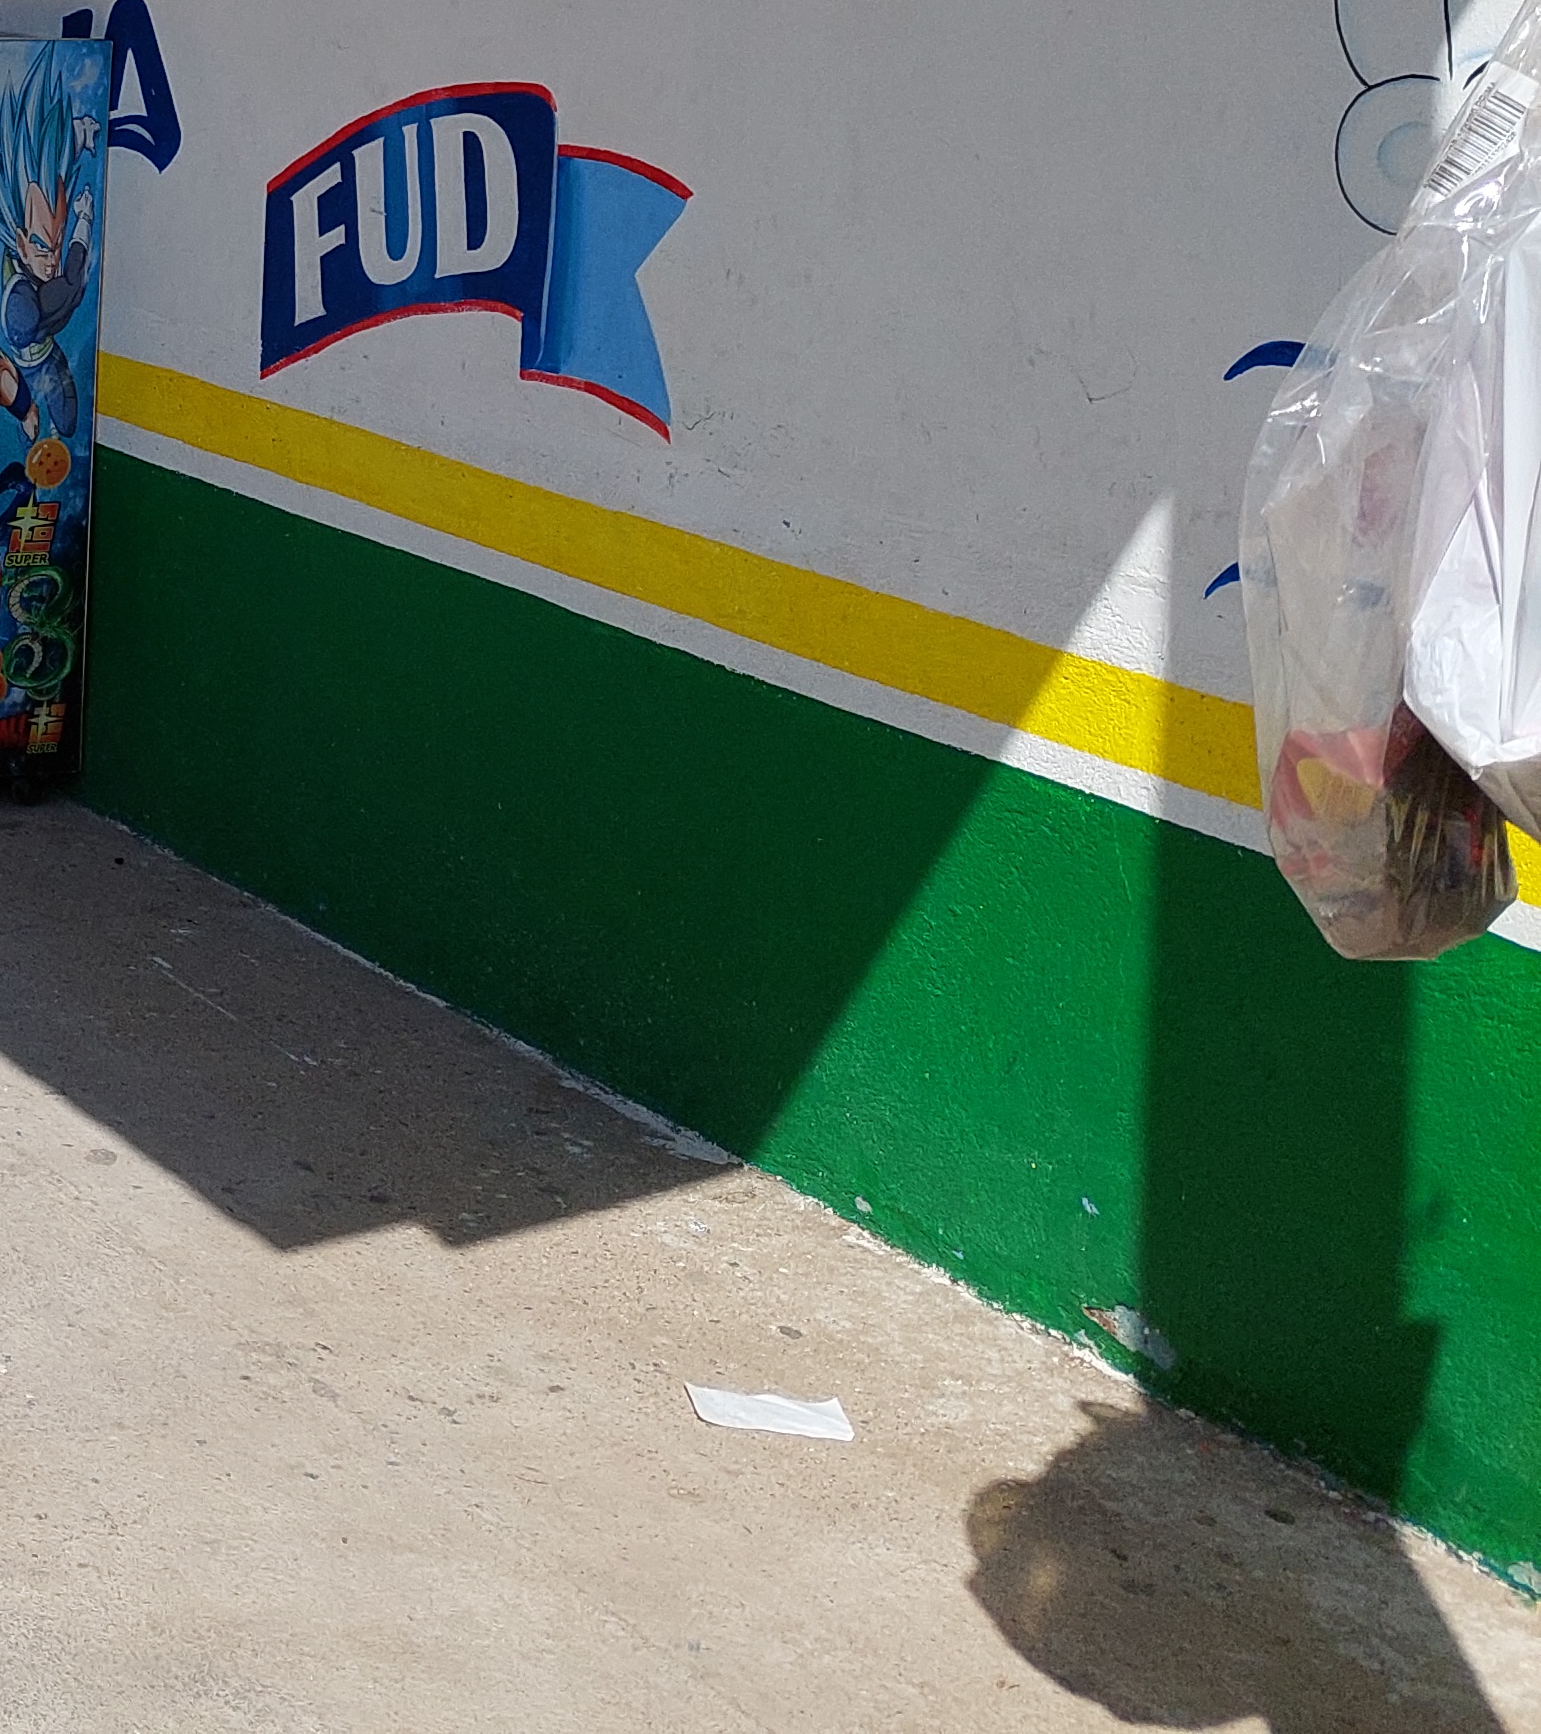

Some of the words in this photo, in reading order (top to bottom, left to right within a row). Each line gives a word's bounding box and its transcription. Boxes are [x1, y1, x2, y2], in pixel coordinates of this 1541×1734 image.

[289, 112, 519, 327] FUD
[5, 552, 49, 566] SUPER
[26, 741, 58, 755] SUPER
